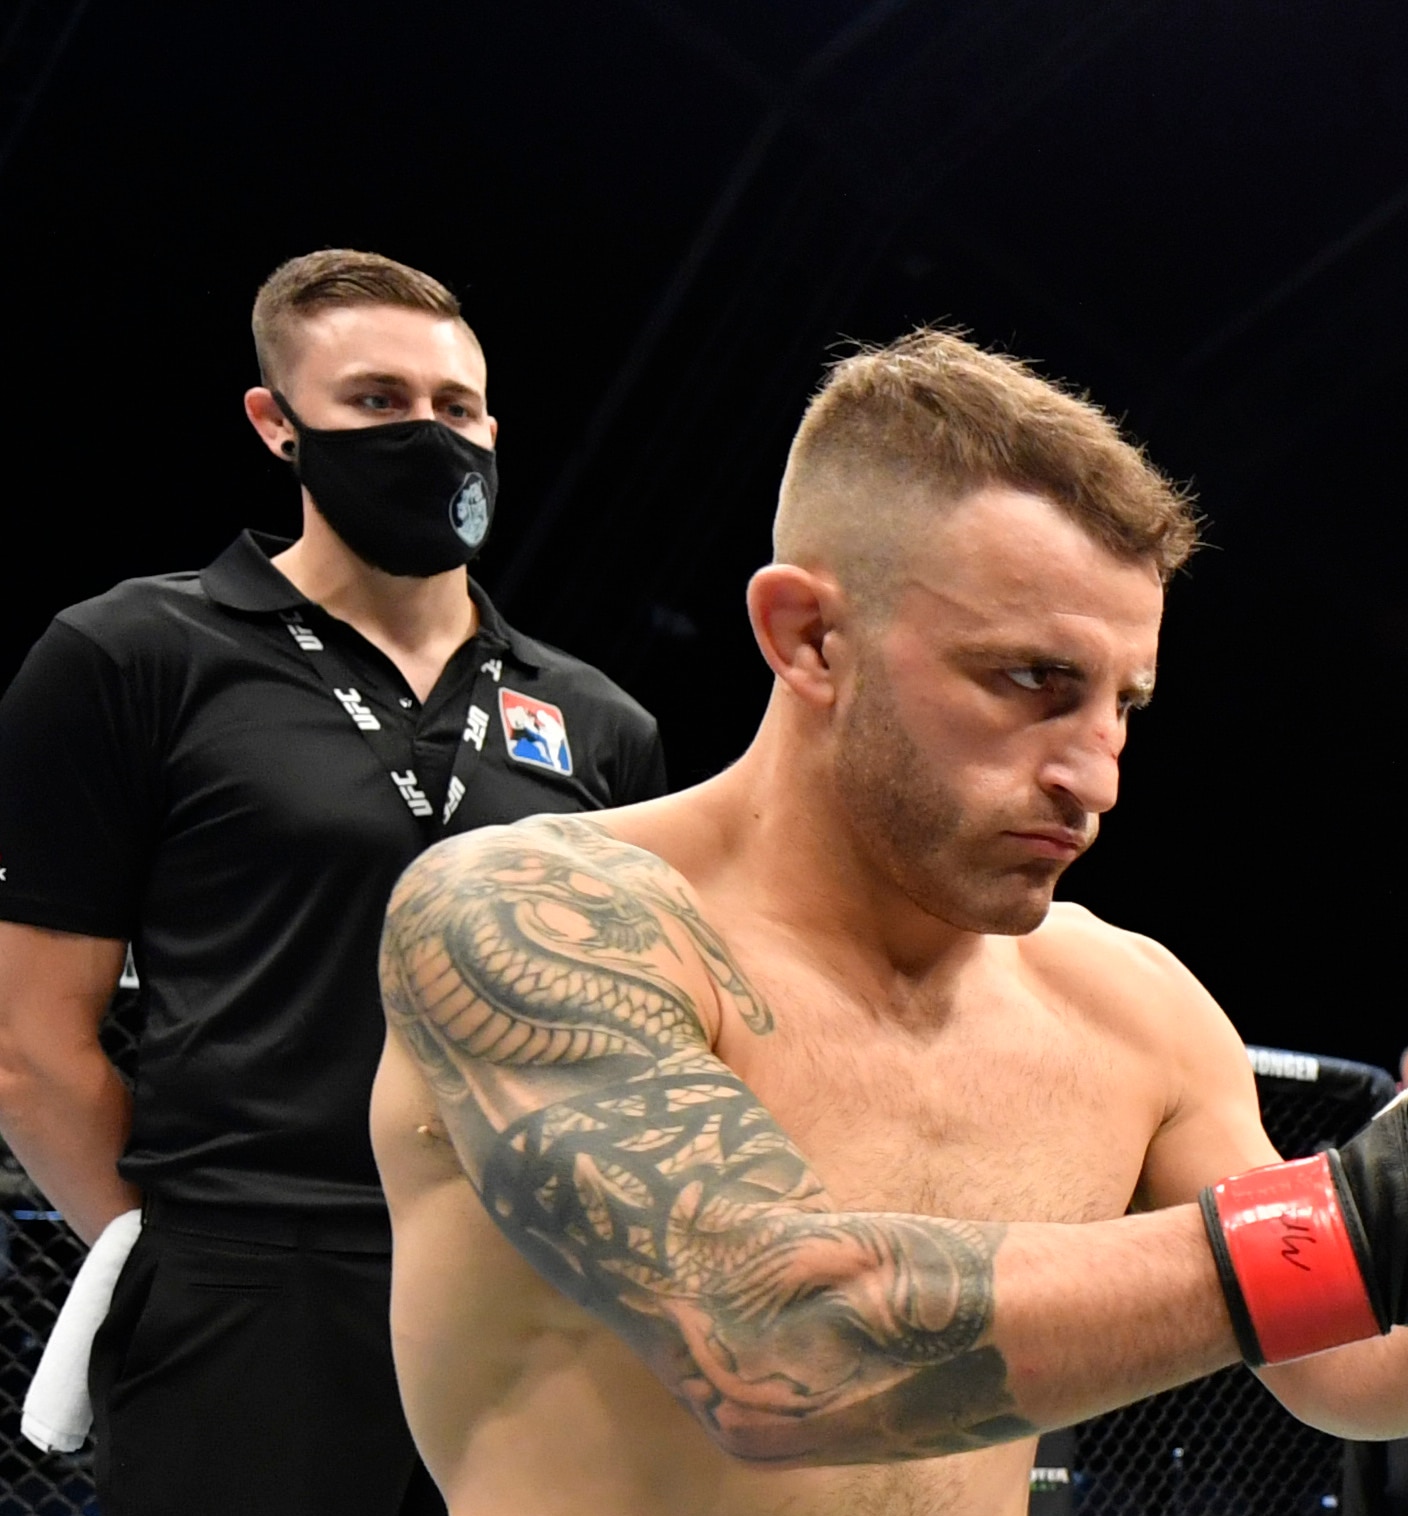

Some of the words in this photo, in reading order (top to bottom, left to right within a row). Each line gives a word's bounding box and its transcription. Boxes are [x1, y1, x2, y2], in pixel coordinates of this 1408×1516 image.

[333, 688, 381, 731] UFC
[463, 705, 490, 751] UFC
[390, 769, 433, 816] UFC
